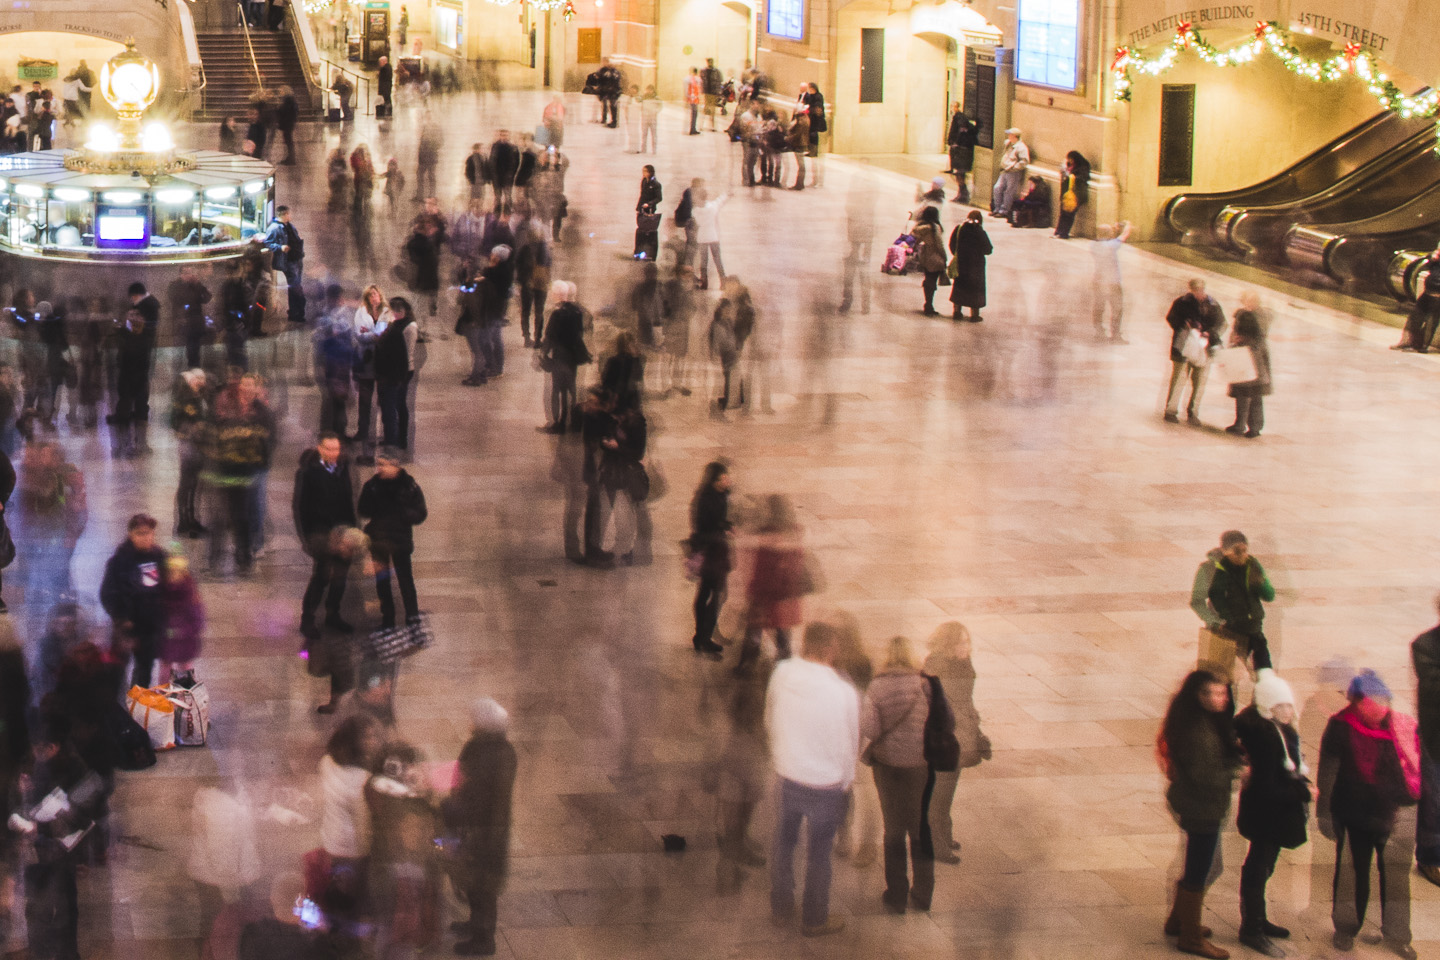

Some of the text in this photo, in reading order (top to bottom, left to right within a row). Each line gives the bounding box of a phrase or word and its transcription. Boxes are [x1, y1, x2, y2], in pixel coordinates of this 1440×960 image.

[1129, 5, 1255, 44] THE METLIFE BUILDING
[1297, 11, 1390, 52] 45TH STREET
